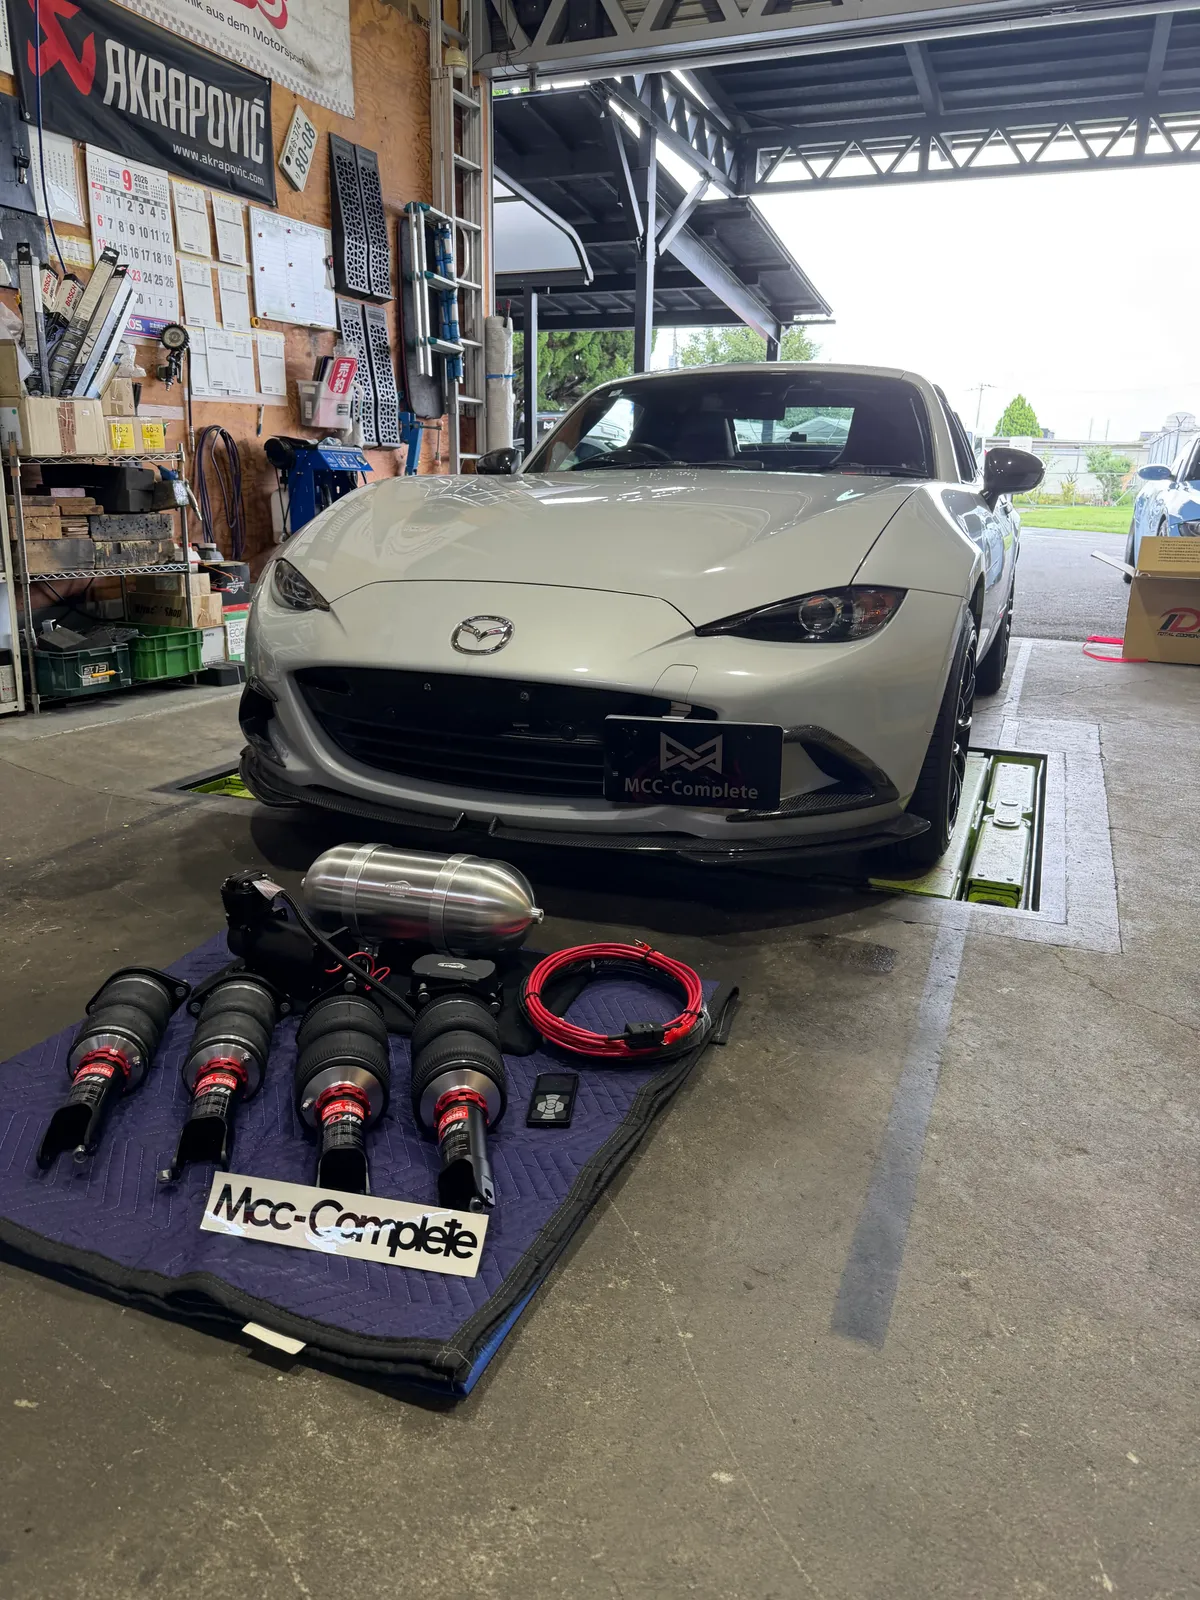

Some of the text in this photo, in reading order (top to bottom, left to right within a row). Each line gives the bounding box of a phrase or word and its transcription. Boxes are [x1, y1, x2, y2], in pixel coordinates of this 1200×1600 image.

[206, 5, 225, 22] aus
[227, 15, 250, 35] dem
[253, 26, 308, 69] Motorsport
[295, 122, 316, 175] 80-08
[172, 143, 265, 187] www.akrapovic.com
[122, 169, 132, 191] 9
[134, 174, 149, 185] 2026
[106, 195, 112, 204] 31
[116, 197, 121, 209] 1
[127, 200, 133, 212] 2
[139, 203, 145, 215] 3
[150, 207, 156, 218] 4
[161, 209, 167, 221] 5
[97, 214, 170, 244] 6 7 8 9 10 11 12
[98, 238, 106, 250] 13
[109, 241, 116, 251] 14
[120, 244, 128, 257] 15
[130, 246, 139, 259] 16
[141, 248, 150, 261] 17
[152, 251, 161, 264] 18
[164, 254, 172, 266] 19
[43, 273, 52, 294] BOSCH
[132, 269, 174, 288] 23 24 25 26
[65, 284, 77, 307] BOSCH
[159, 298, 163, 306] 2
[169, 300, 174, 308] 3
[333, 362, 351, 393] 売約
[624, 777, 759, 800] MCC-Complete
[212, 1183, 479, 1260] Mcc-Complete
